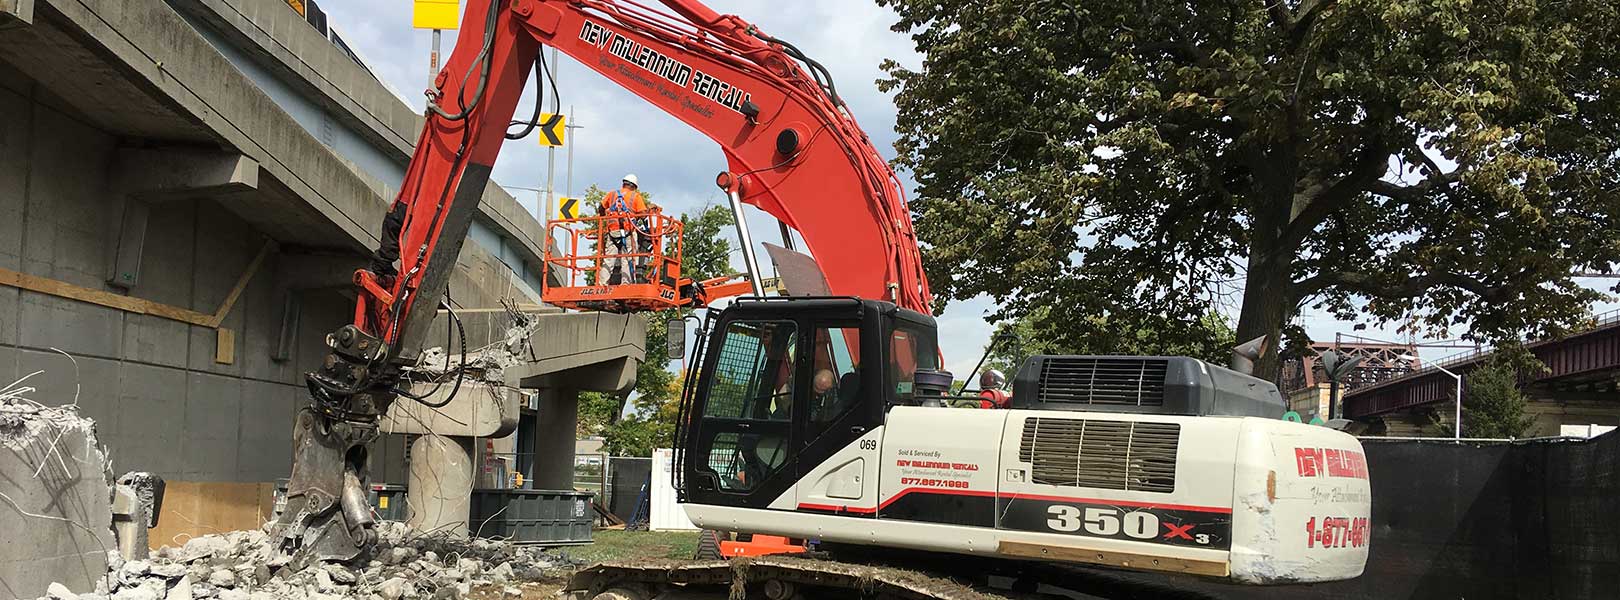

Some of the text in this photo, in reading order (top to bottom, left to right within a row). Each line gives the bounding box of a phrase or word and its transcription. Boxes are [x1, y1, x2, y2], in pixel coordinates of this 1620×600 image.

[579, 19, 613, 50] NEW
[608, 33, 693, 88] MILLENNIUM
[581, 288, 594, 296] JLG
[660, 289, 675, 300] JLG
[860, 439, 877, 450] 069
[912, 461, 950, 469] MILLENNIUM
[952, 463, 979, 471] RENTALS
[1295, 447, 1324, 479] NEW
